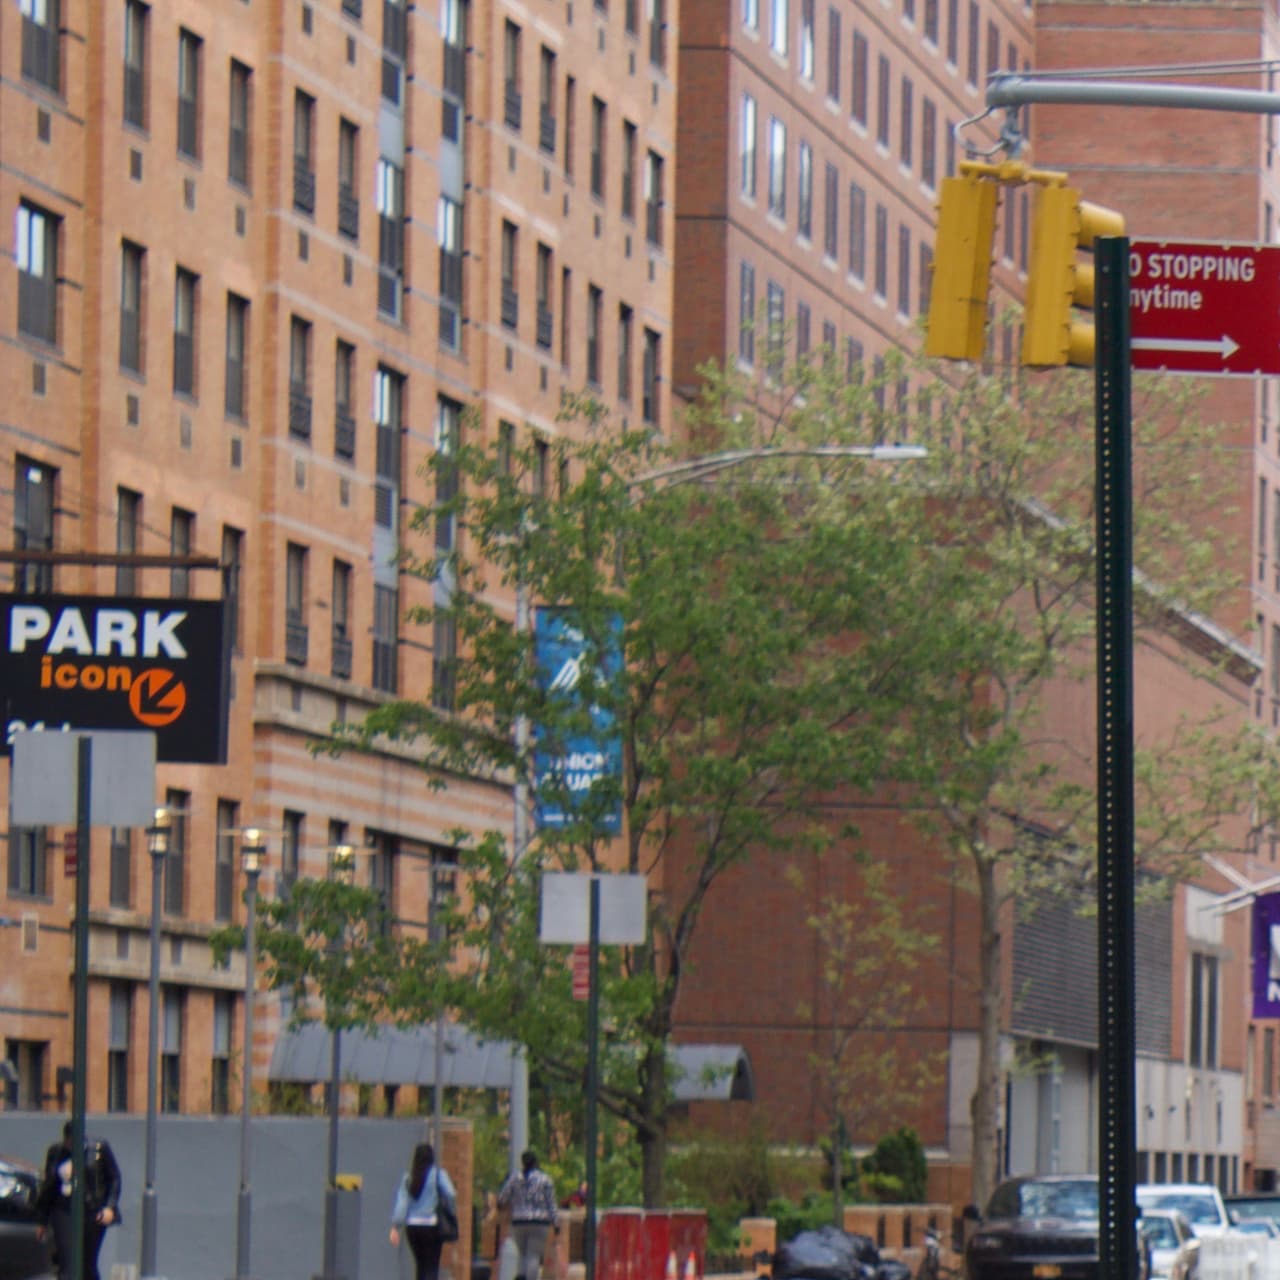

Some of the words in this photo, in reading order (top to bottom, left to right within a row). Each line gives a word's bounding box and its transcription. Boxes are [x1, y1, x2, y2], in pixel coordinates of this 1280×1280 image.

[1147, 253, 1256, 282] STOPPING
[1129, 283, 1204, 314] nytime
[8, 604, 189, 660] PARK
[40, 655, 133, 692] icon
